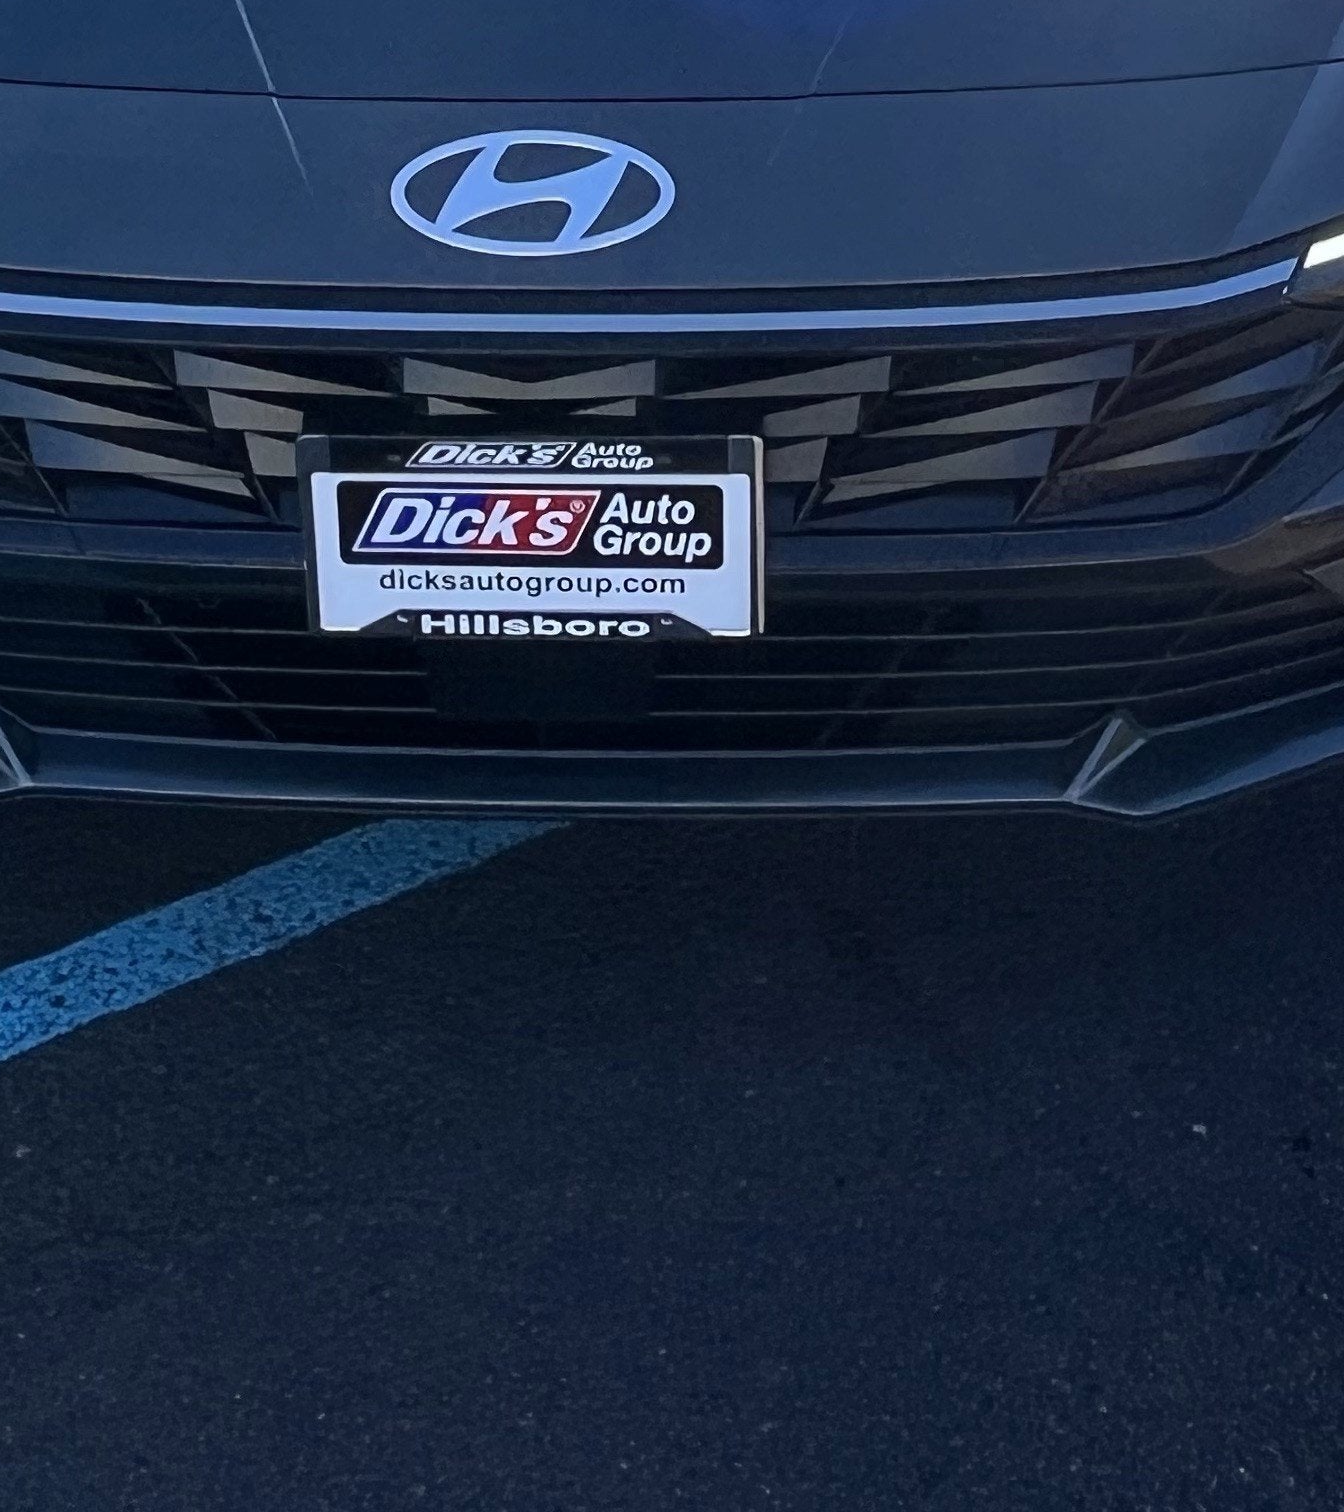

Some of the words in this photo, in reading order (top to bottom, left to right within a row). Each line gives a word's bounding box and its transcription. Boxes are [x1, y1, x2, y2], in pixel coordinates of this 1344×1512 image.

[419, 444, 563, 464] Dick's
[577, 442, 641, 456] Auto
[571, 455, 654, 470] Group
[370, 496, 574, 547] Dick's
[600, 492, 695, 525] Auto
[593, 524, 712, 563] Group
[379, 568, 685, 597] dicksautogroup.com
[420, 613, 651, 636] Hillsboro
